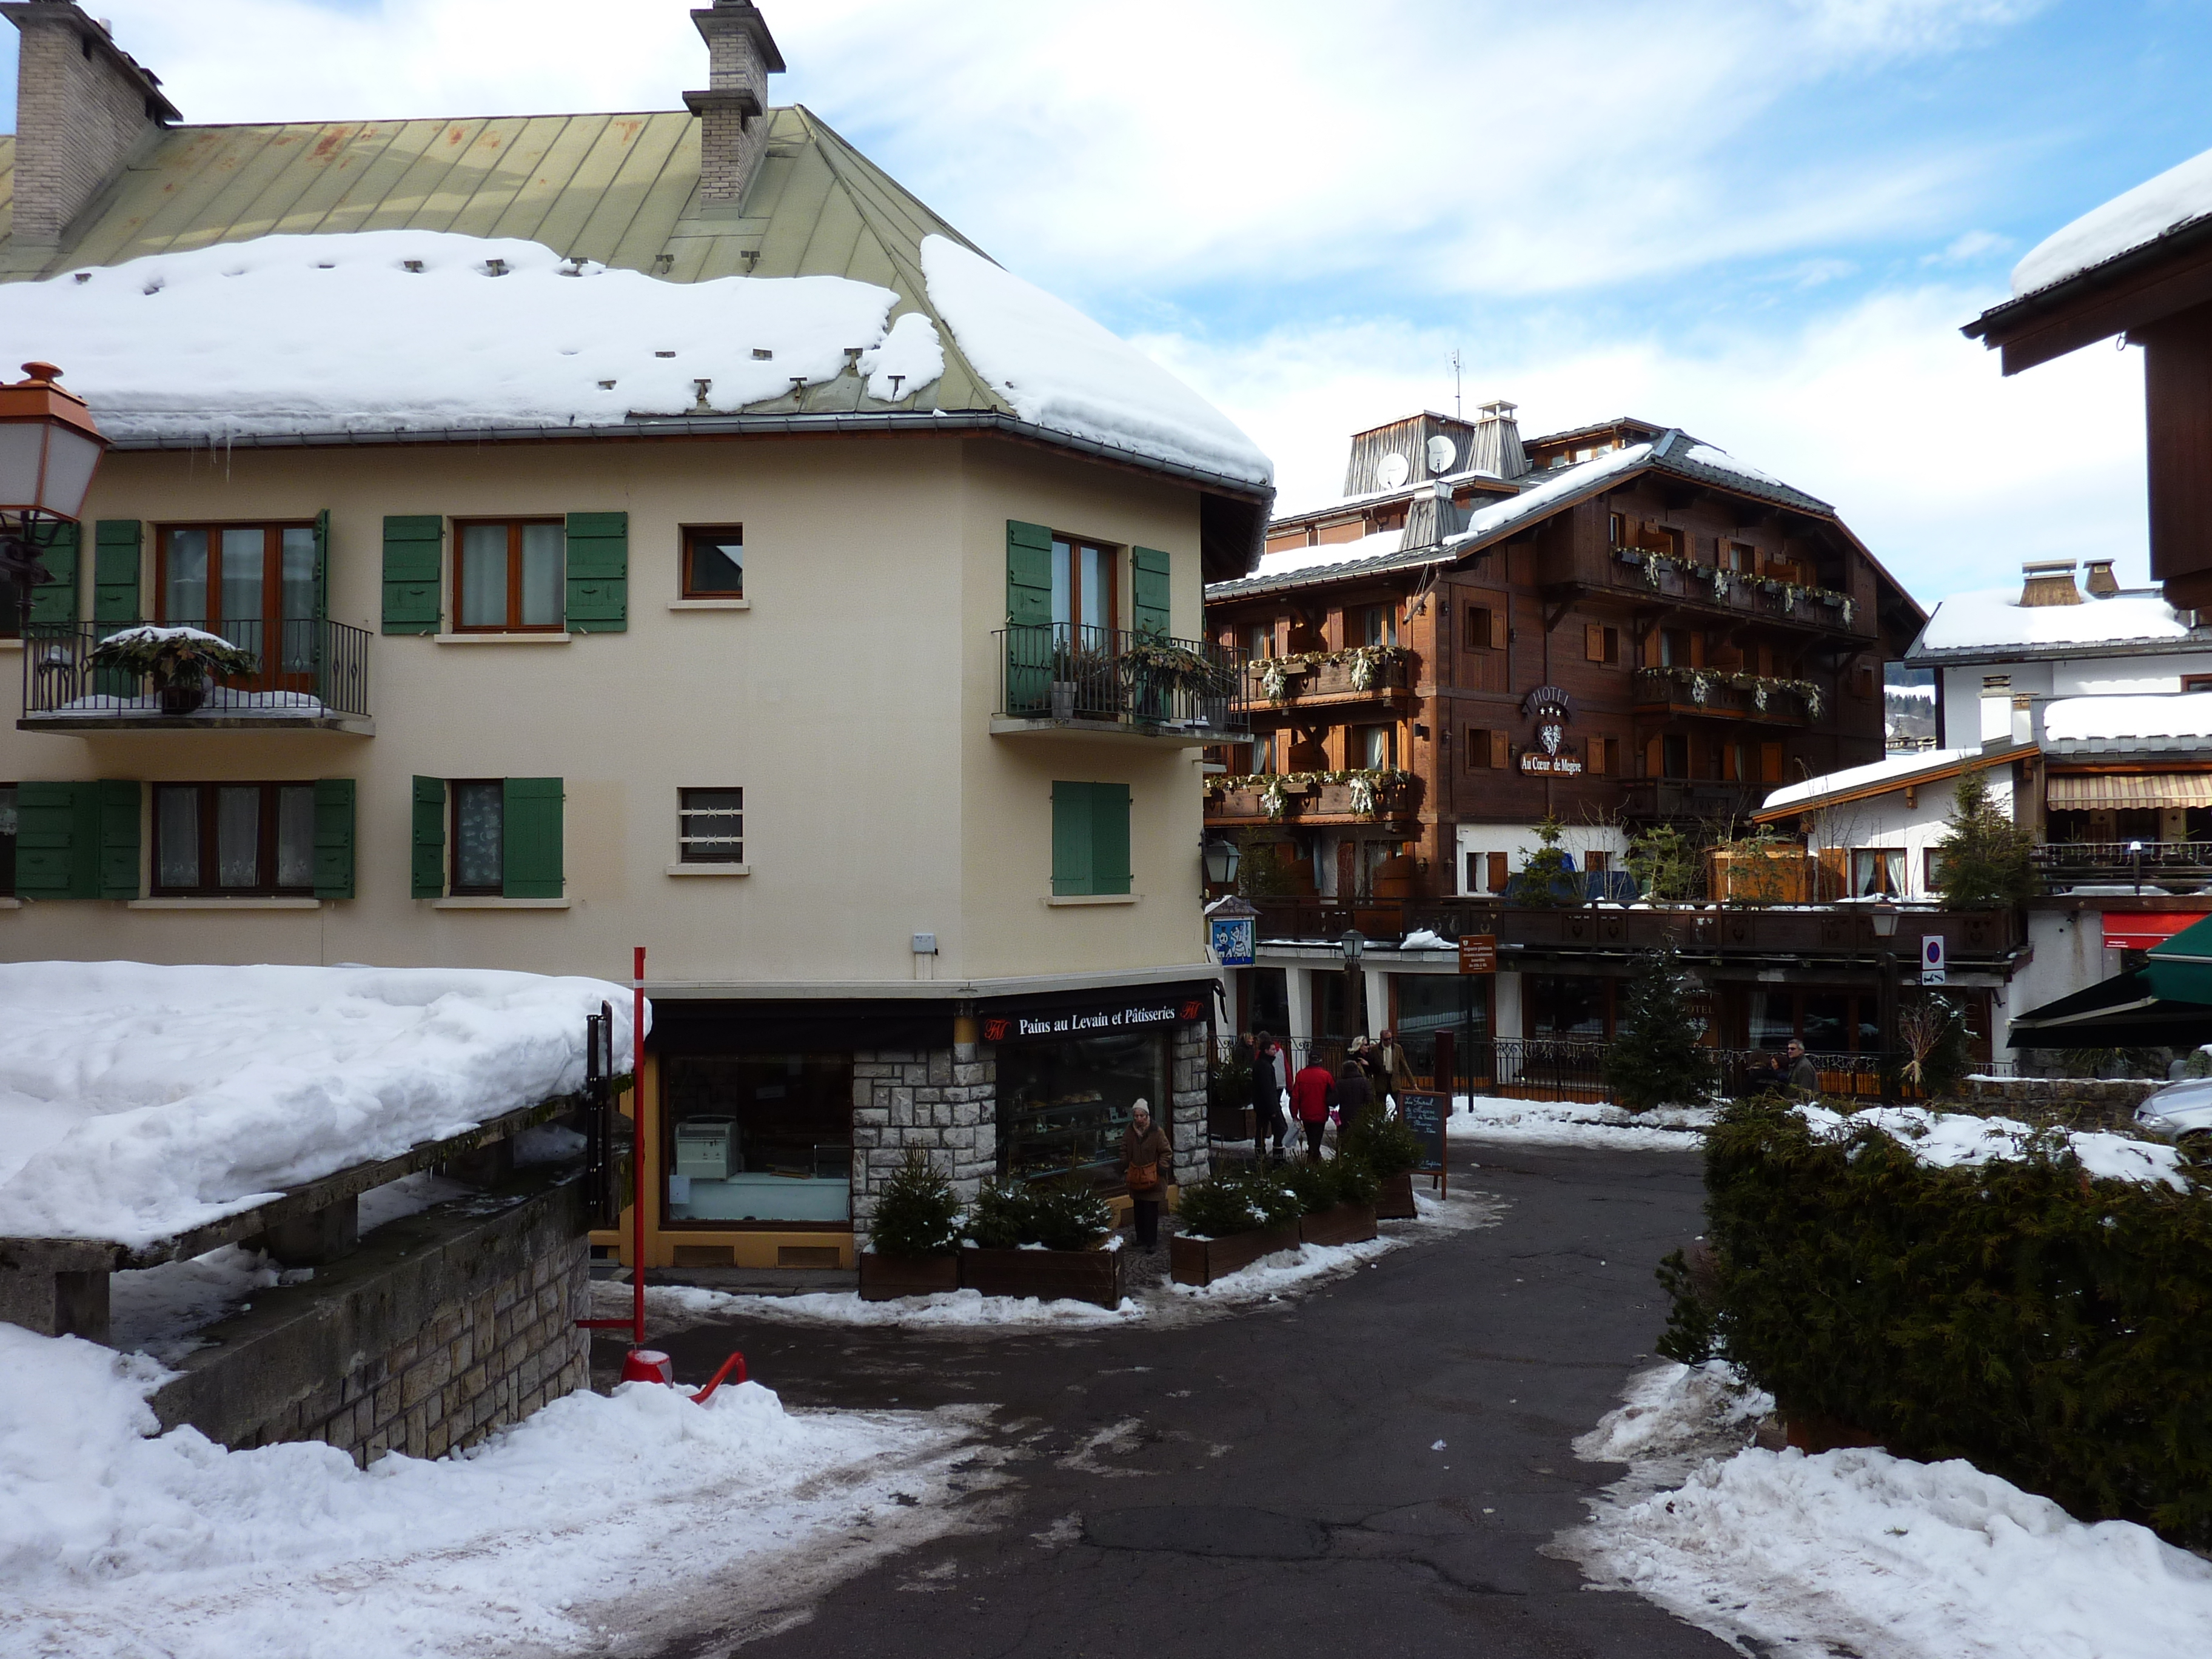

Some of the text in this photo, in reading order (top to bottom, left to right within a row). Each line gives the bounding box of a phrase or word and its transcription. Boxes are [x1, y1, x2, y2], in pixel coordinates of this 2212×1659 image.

[1521, 756, 1531, 770] Au
[1553, 758, 1561, 771] de
[1019, 1018, 1051, 1034] Pains
[1054, 1020, 1068, 1031] au
[1072, 1014, 1108, 1030] Levain
[1111, 1013, 1122, 1025] et
[1124, 1006, 1175, 1024] Pâtisseries
